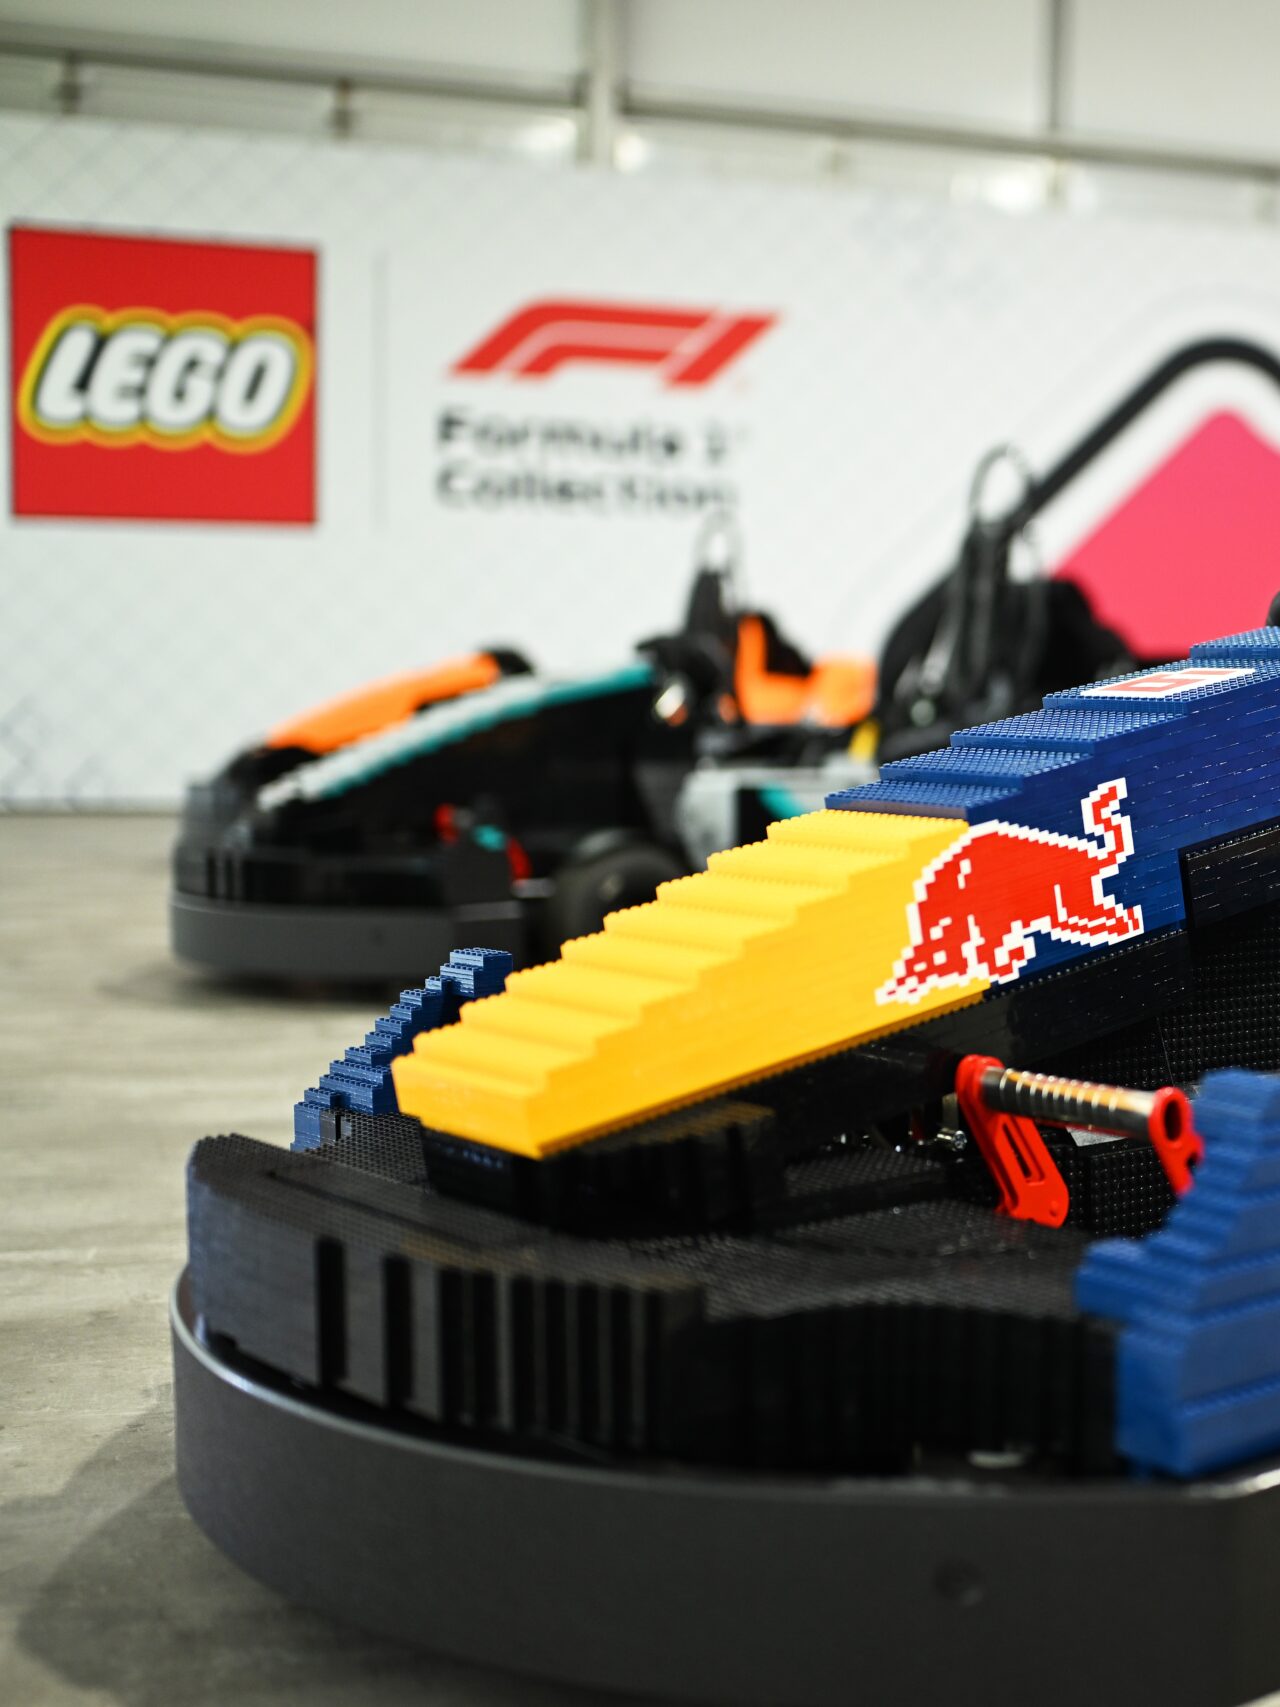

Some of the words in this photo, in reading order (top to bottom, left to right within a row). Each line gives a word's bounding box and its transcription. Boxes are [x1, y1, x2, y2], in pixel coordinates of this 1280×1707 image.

[452, 298, 776, 386] F1
[33, 320, 300, 434] LEGO
[437, 406, 682, 461] Formula
[438, 461, 738, 511] Collection
[1099, 670, 1237, 692] 6
